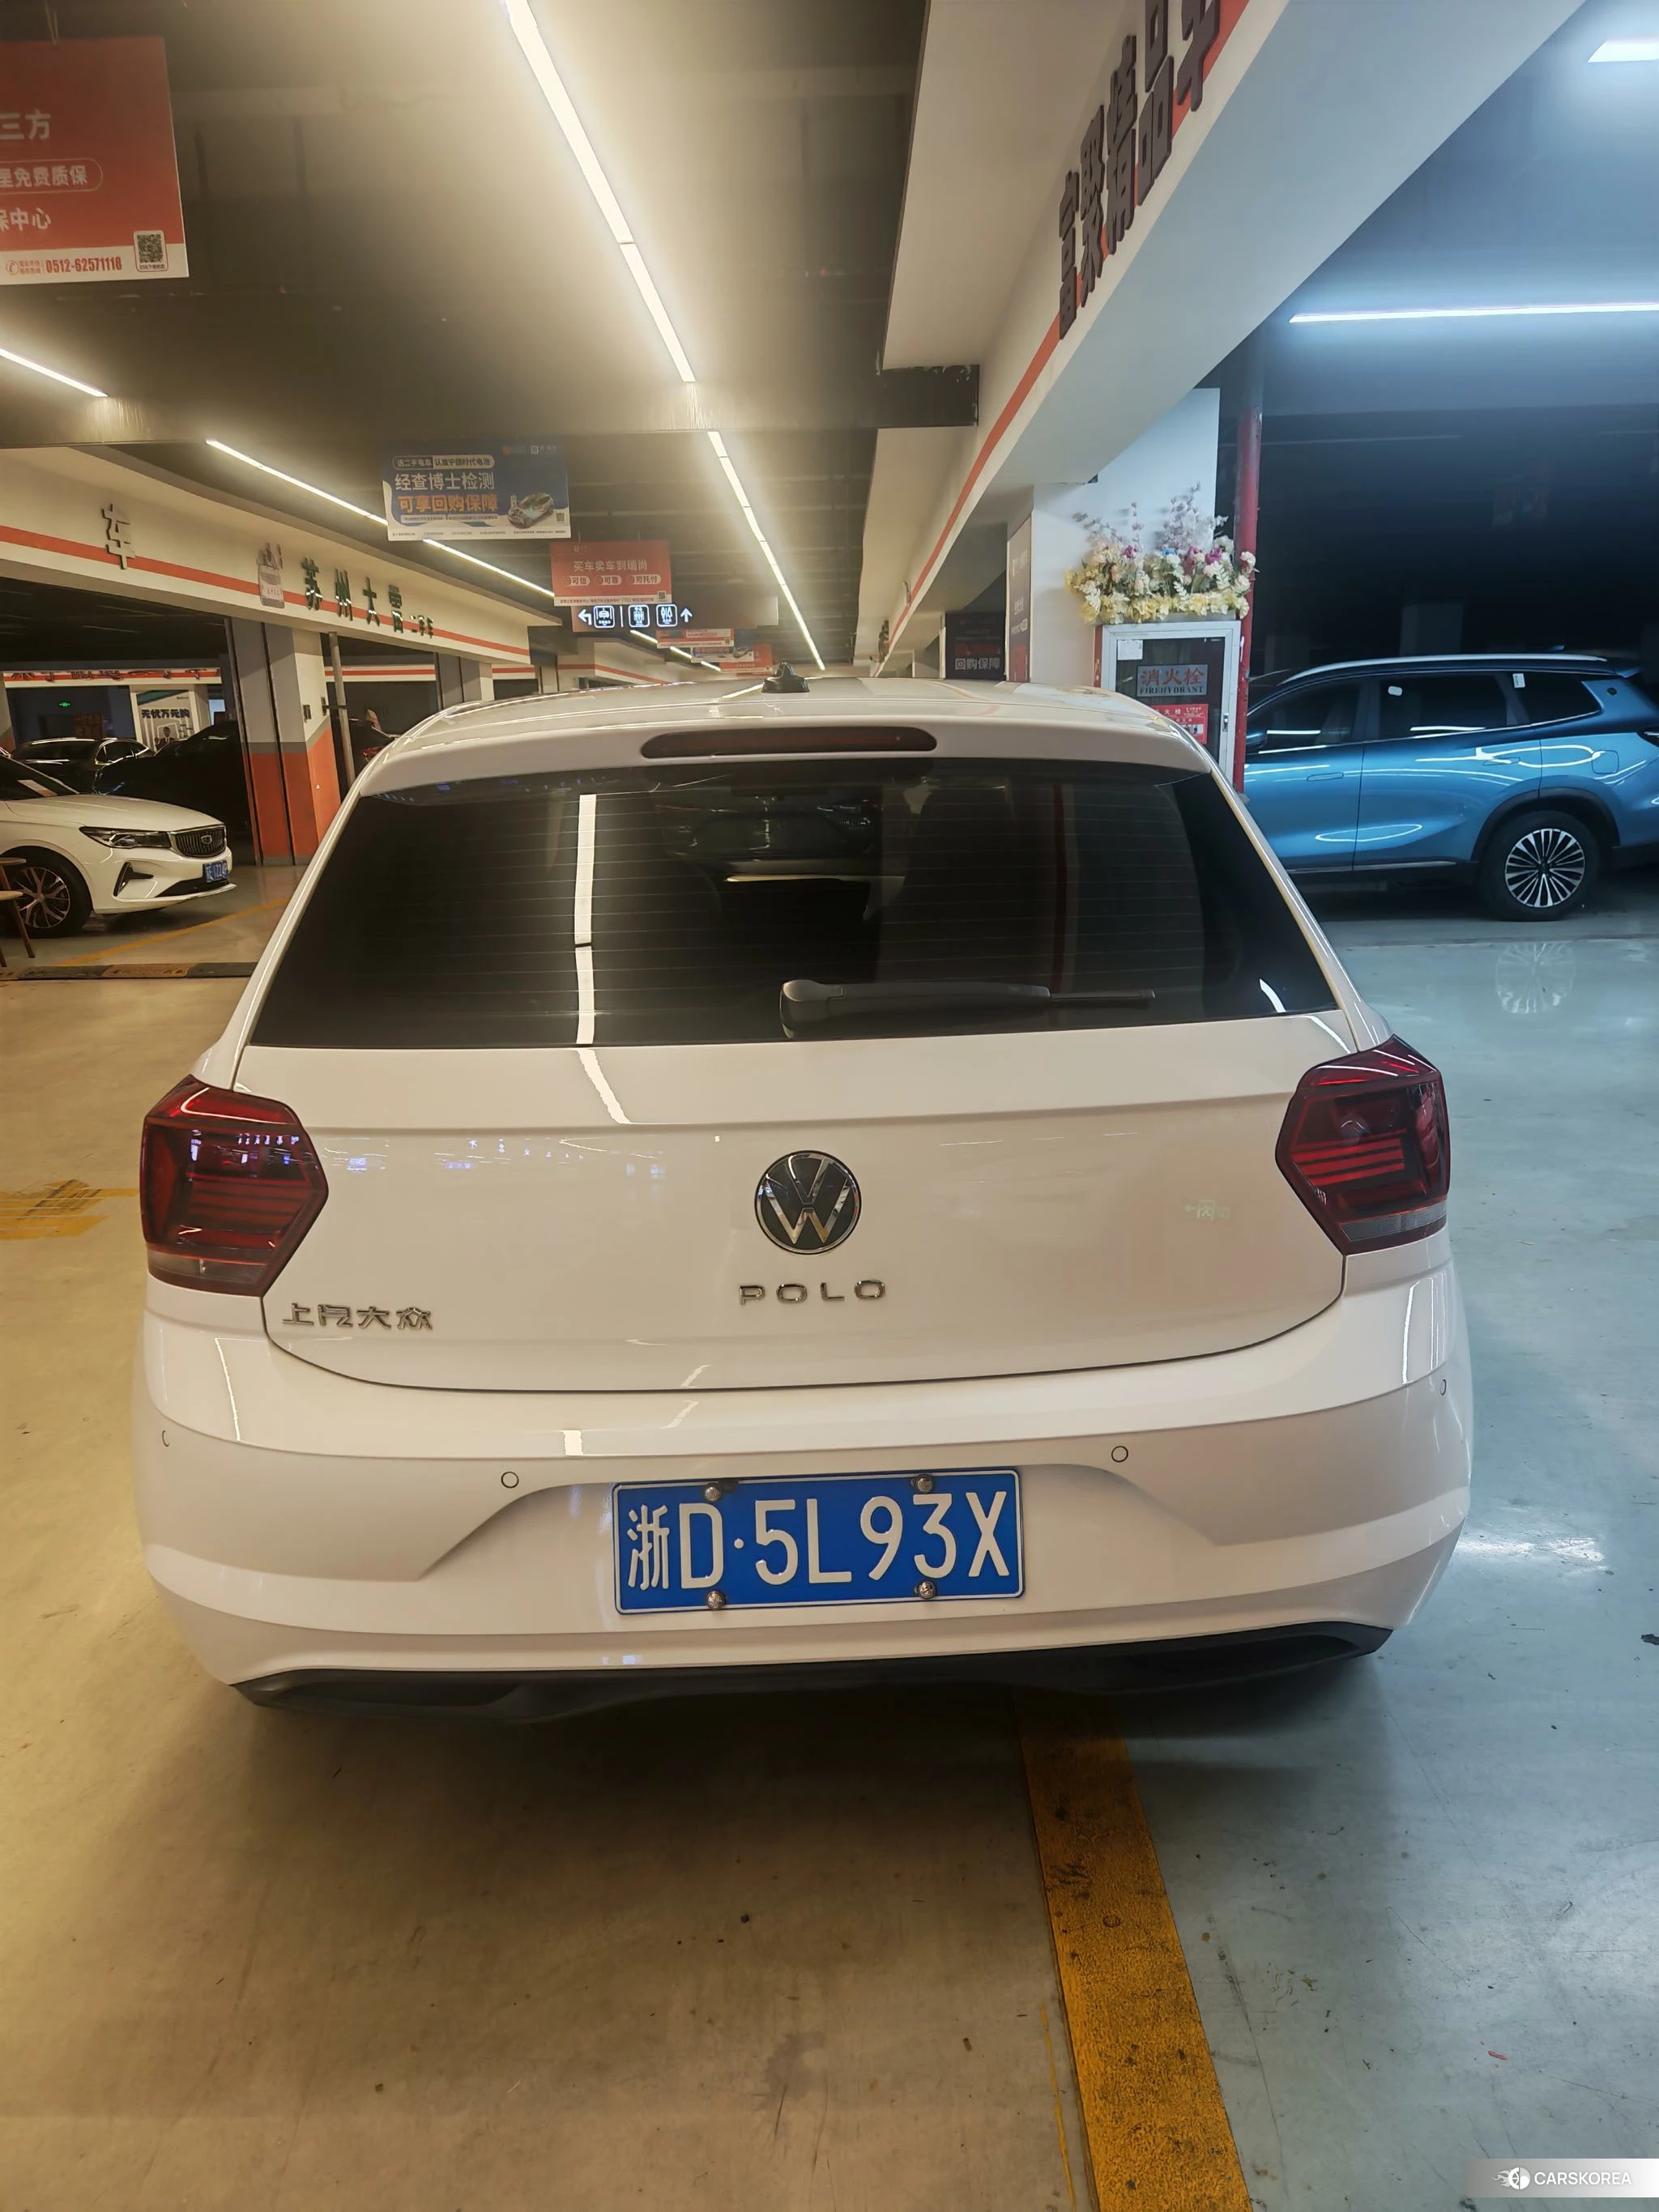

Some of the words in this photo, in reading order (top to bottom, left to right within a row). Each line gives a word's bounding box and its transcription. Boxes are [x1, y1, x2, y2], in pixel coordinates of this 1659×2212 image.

[45, 256, 122, 273] 0512-62571118
[394, 472, 495, 490] 经查博士检测
[398, 494, 498, 513] 可享回购保障
[954, 657, 1000, 671] 回购保障
[1140, 667, 1205, 686] 消火栓
[738, 1279, 886, 1305] POLO
[282, 1302, 433, 1331] 上汽大众
[627, 1490, 1010, 1591] 浙D·5L93X
